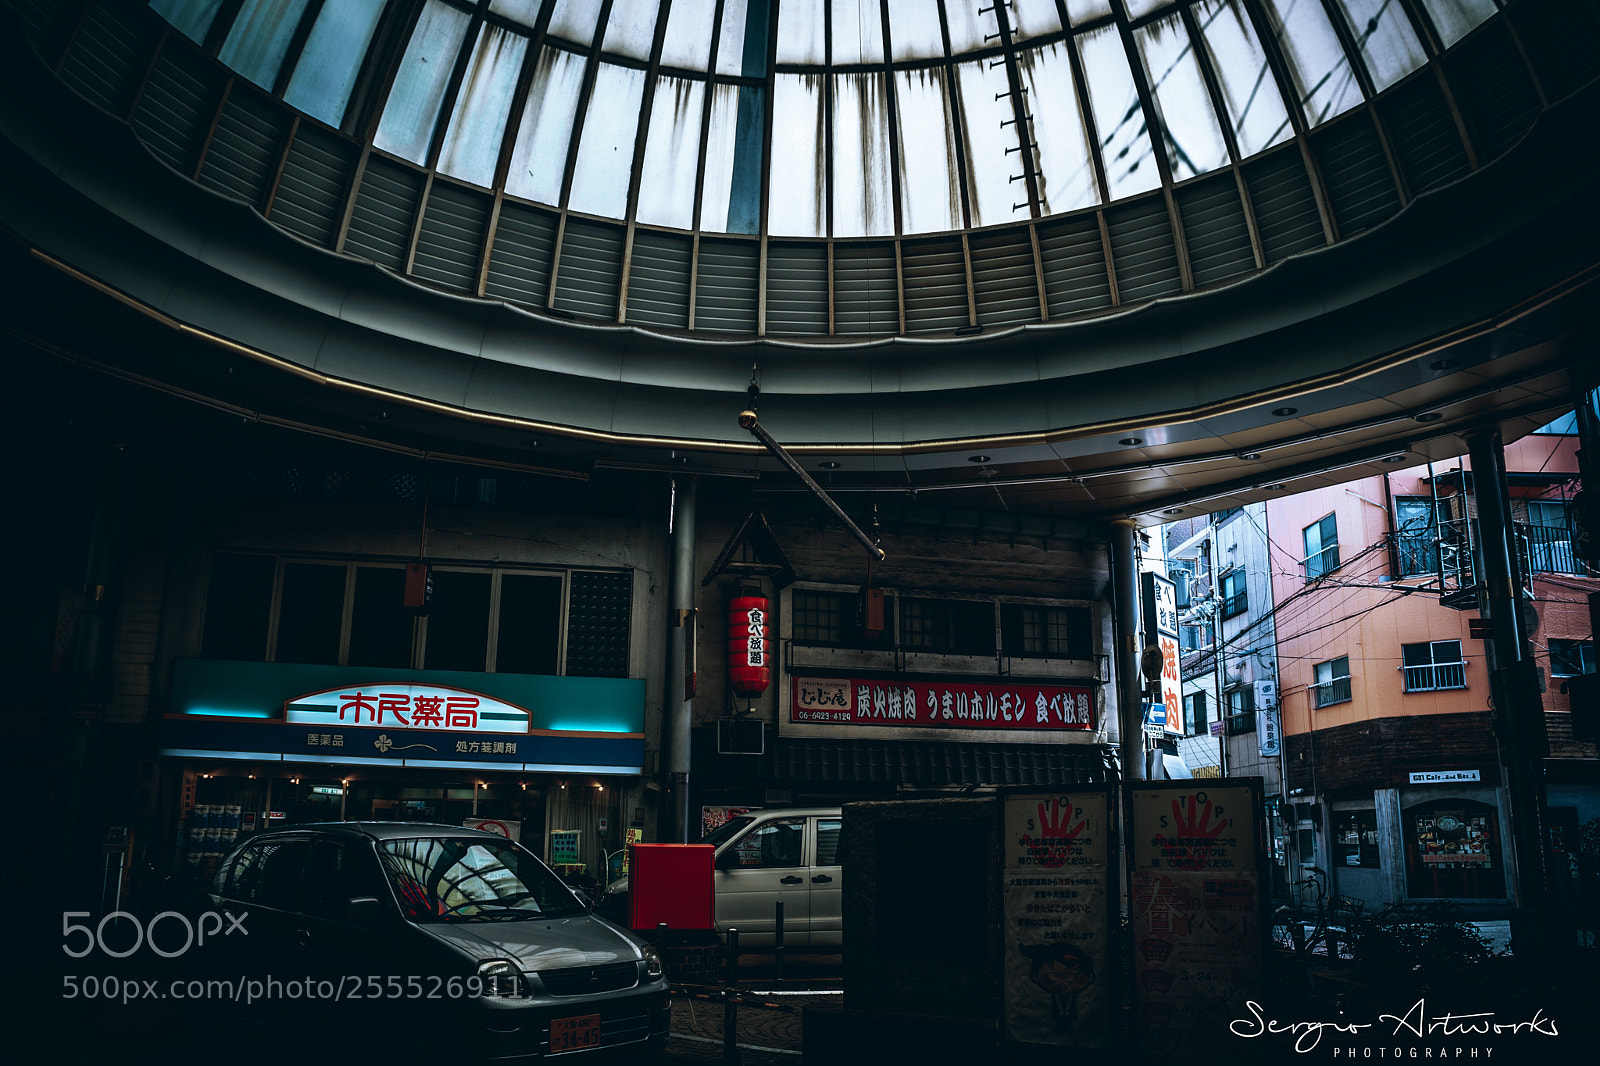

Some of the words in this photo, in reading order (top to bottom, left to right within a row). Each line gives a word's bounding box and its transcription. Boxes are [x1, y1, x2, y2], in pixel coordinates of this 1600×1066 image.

[750, 610, 762, 664] 食べ放題
[339, 691, 480, 728] 市民薬局
[857, 684, 917, 720] 炭火焼肉
[927, 688, 1026, 722] うまいホルモン
[1034, 690, 1091, 725] 食べ放題
[307, 732, 344, 748] 医薬品
[561, 1027, 599, 1050] 34-45
